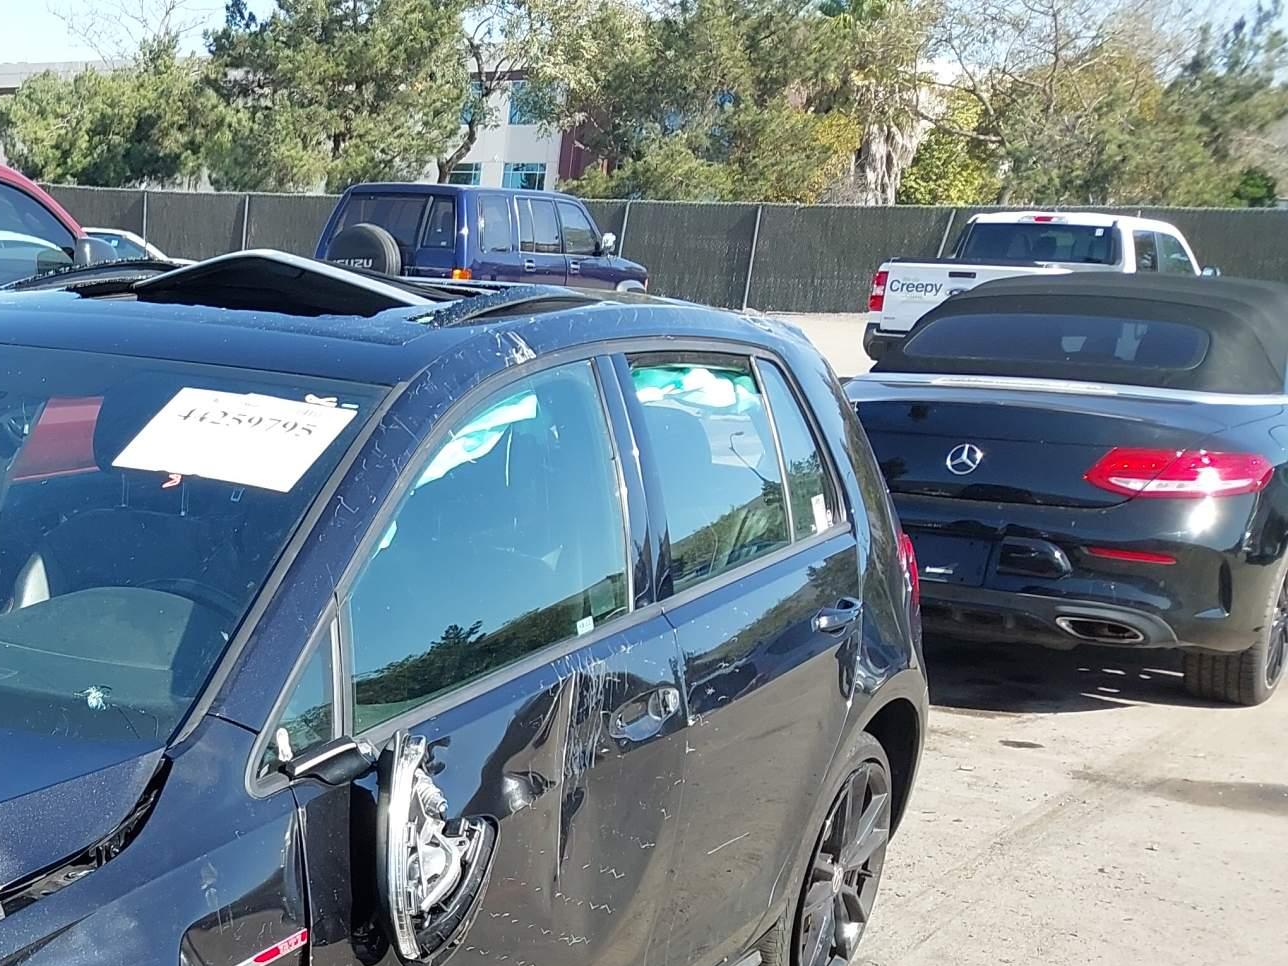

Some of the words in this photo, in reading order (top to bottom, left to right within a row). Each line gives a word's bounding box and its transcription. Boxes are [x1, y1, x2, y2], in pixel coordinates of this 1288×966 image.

[333, 258, 373, 268] SUZU
[889, 279, 943, 297] Creepy
[178, 407, 318, 437] 44259795
